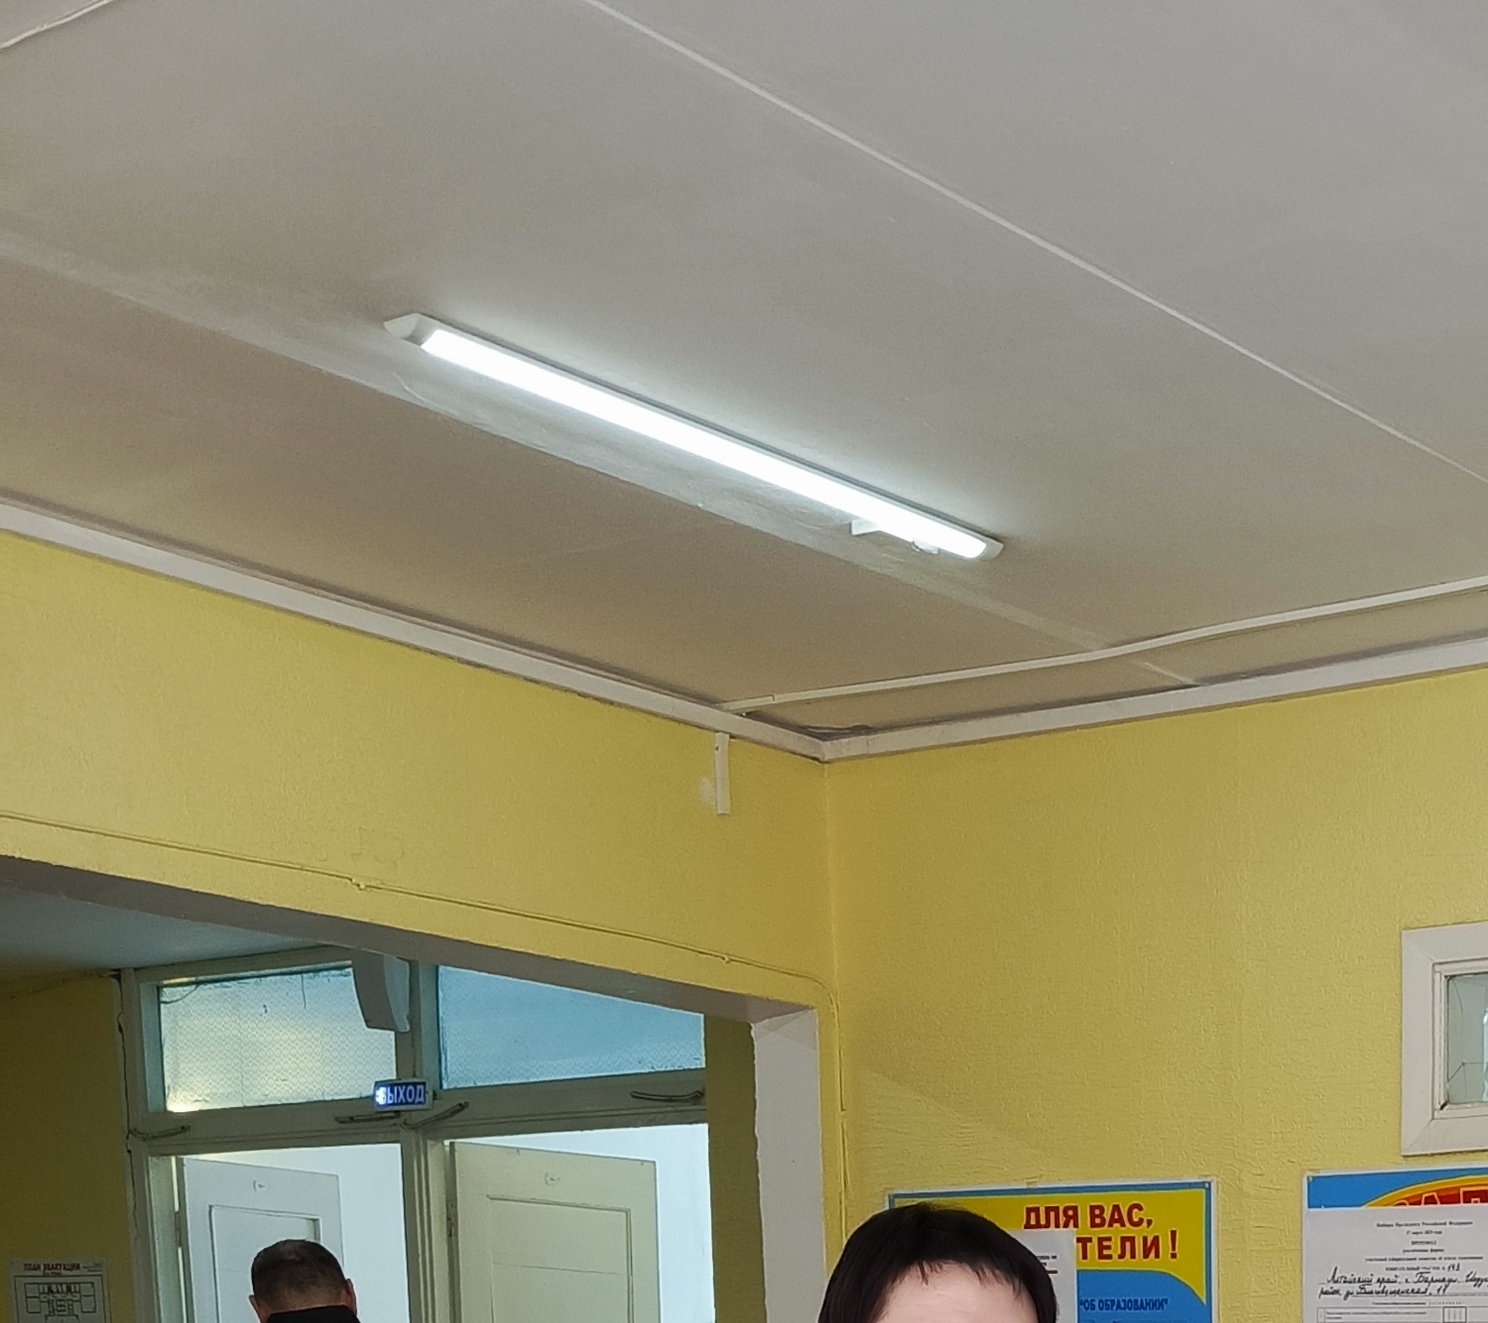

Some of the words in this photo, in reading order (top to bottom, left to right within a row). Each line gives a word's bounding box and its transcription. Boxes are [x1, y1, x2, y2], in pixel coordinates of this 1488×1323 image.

[376, 1084, 425, 1105] ВЫХОД
[1023, 1205, 1080, 1230] ДЛЯ
[1089, 1203, 1154, 1229] ВАС,
[1076, 1230, 1178, 1261] ТЕЛИ!
